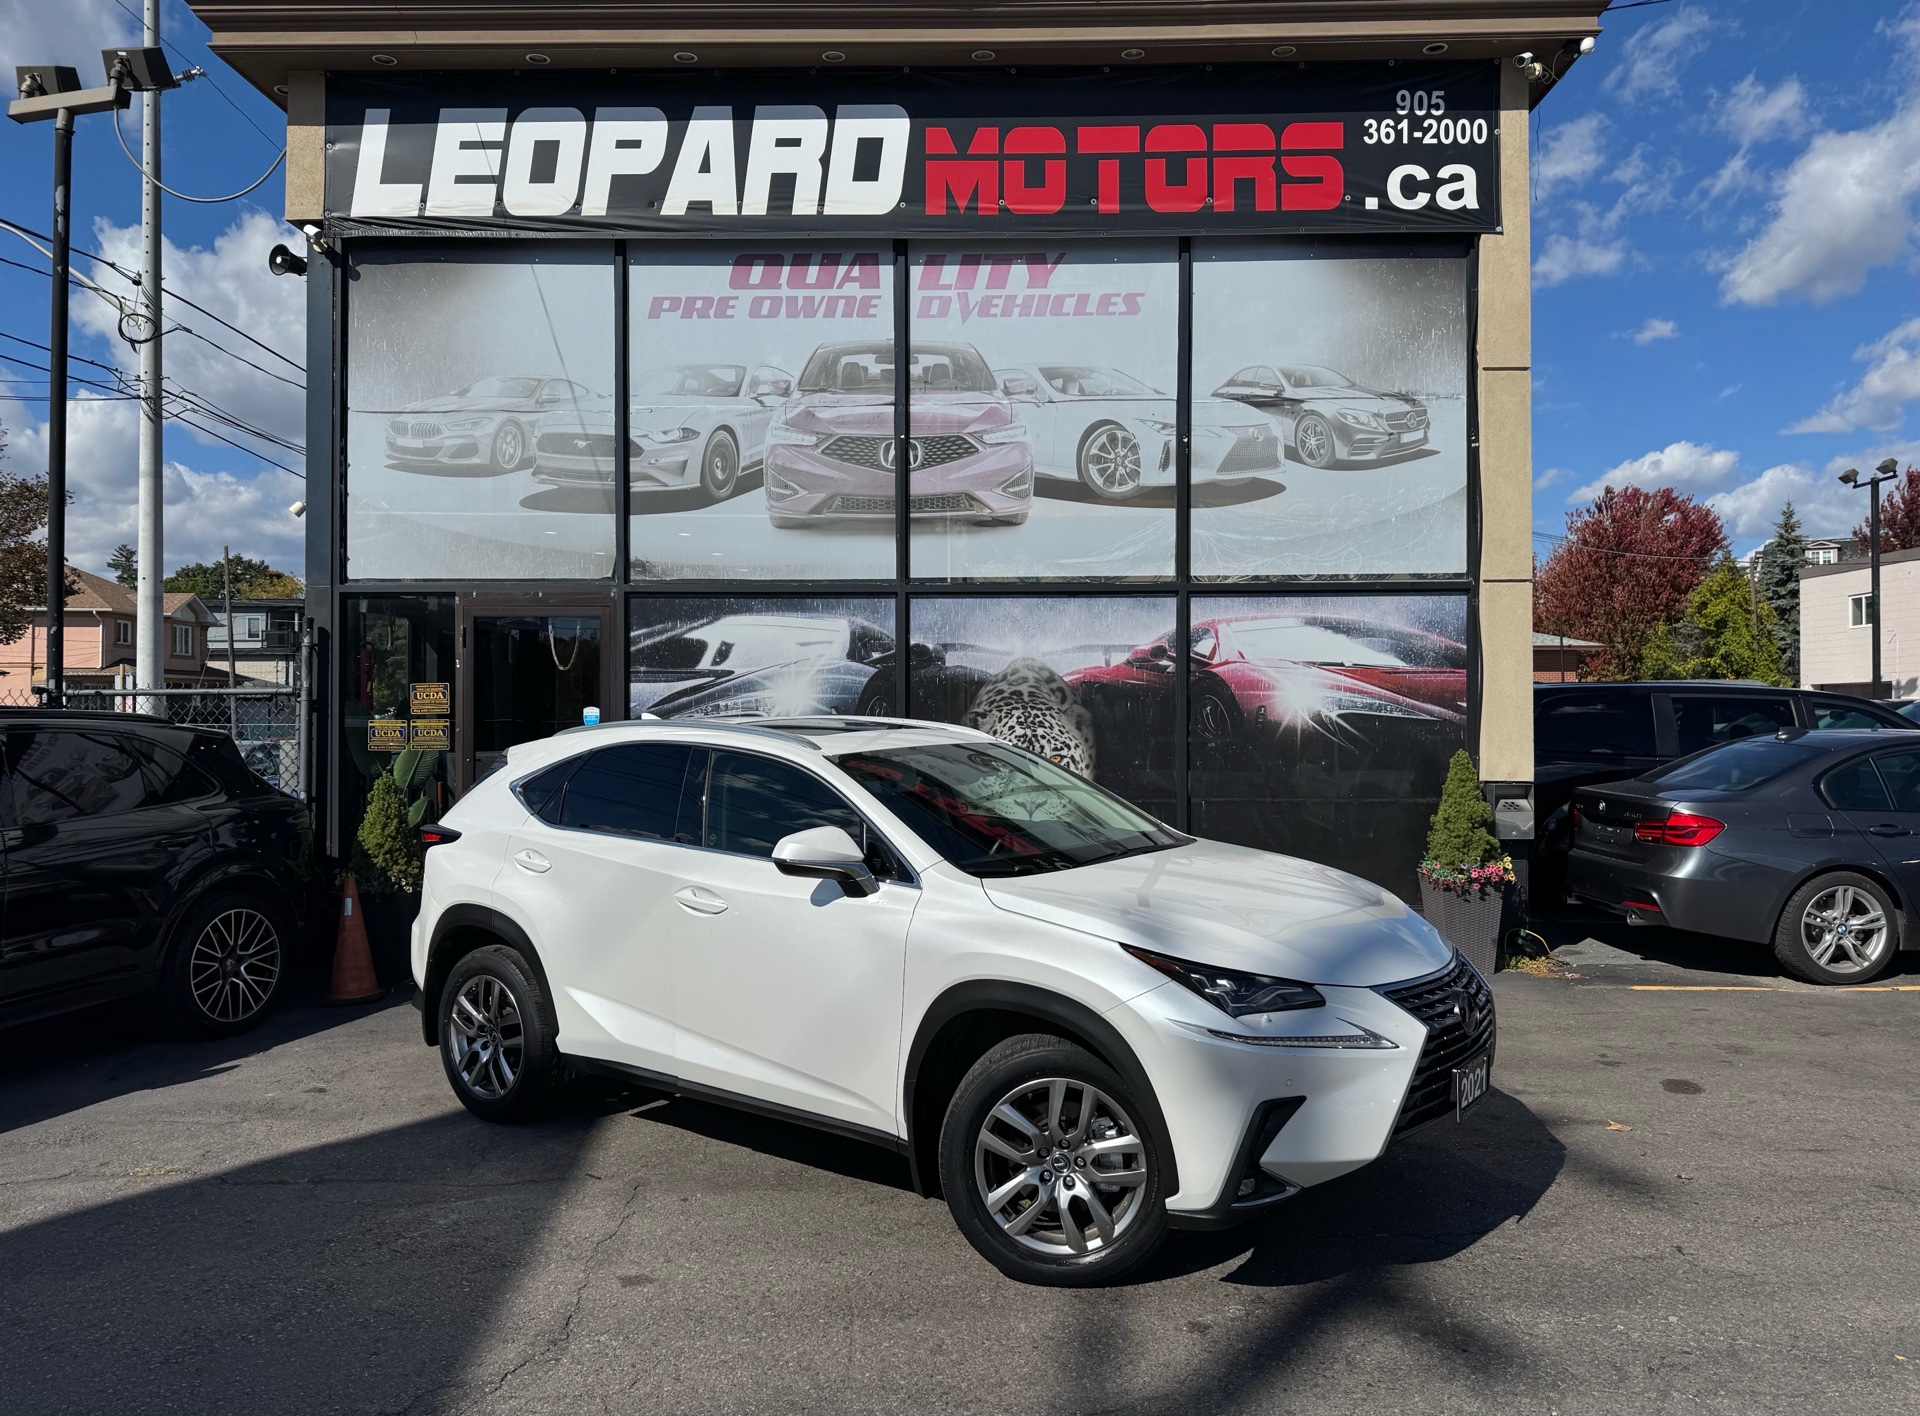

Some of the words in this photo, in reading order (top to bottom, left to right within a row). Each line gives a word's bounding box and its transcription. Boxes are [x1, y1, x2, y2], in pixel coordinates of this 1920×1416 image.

[1395, 90, 1446, 116] 905
[1363, 117, 1488, 146] 361-2000
[350, 103, 911, 218] LEOPARD
[924, 121, 1344, 216] MOTORS
[1364, 163, 1480, 211] .ca
[647, 295, 738, 320] PRE
[416, 691, 444, 699] UCDA
[417, 729, 444, 737] UCDA
[1461, 1063, 1487, 1109] 2021
